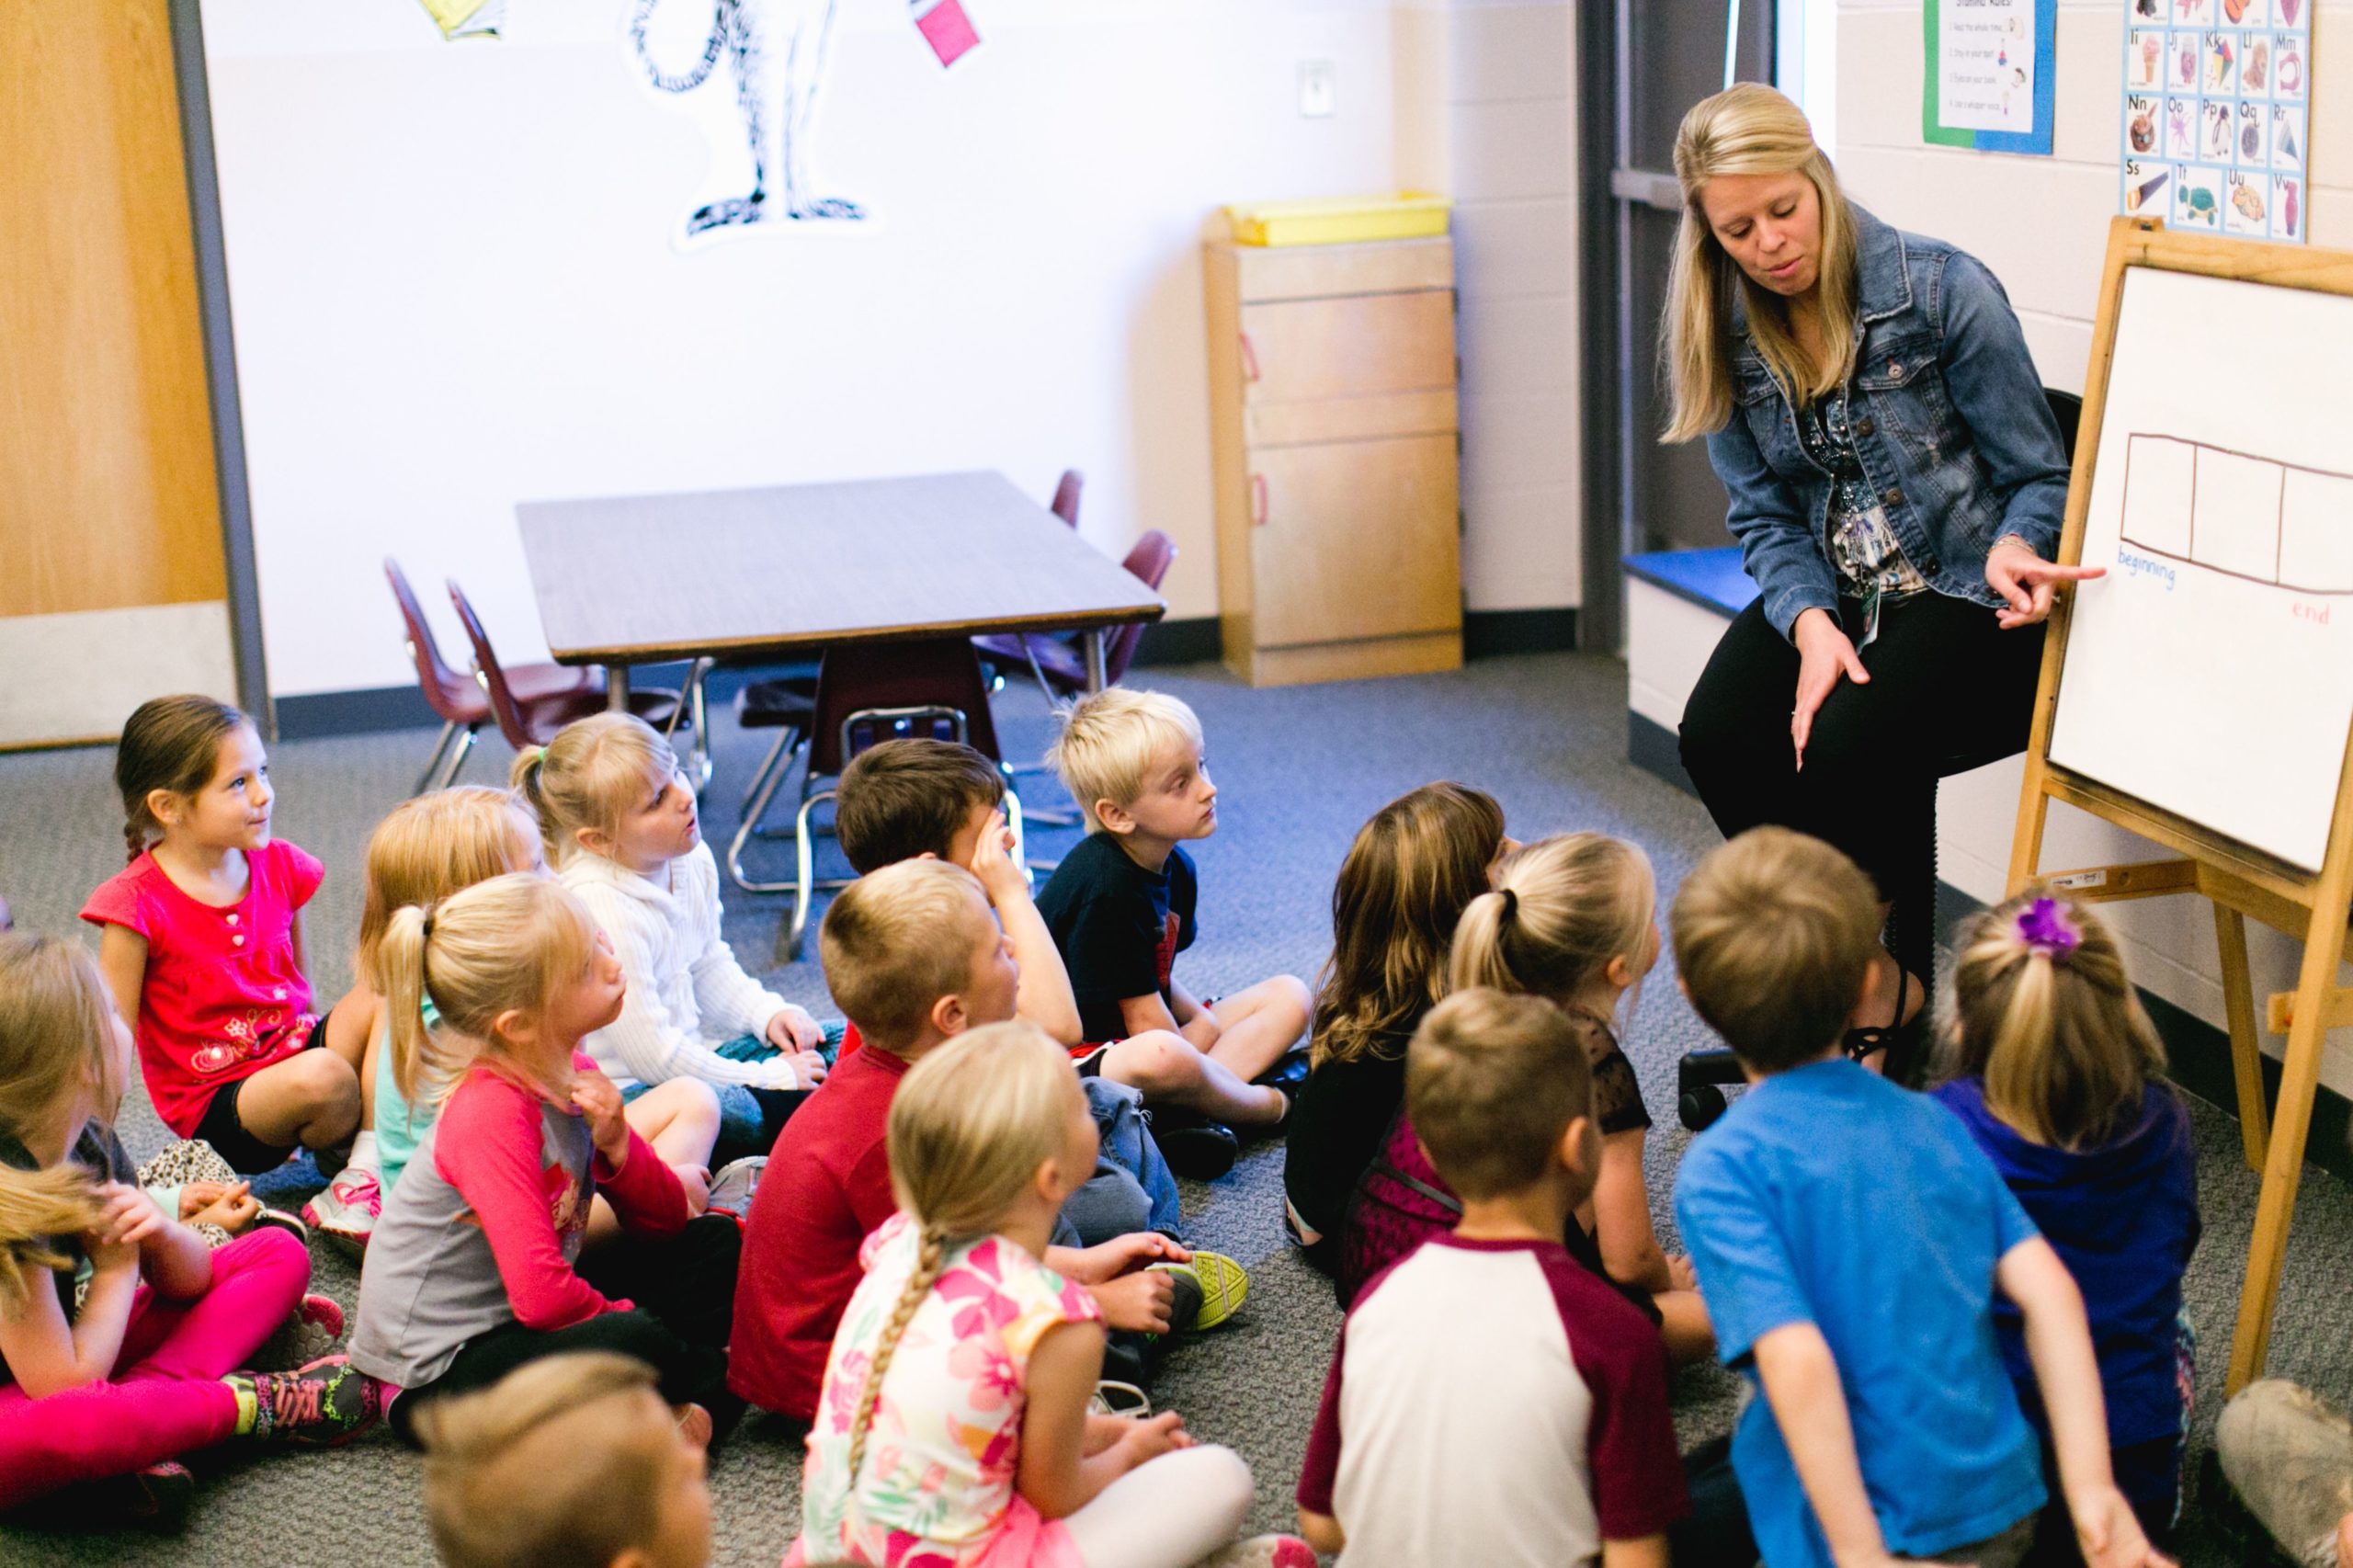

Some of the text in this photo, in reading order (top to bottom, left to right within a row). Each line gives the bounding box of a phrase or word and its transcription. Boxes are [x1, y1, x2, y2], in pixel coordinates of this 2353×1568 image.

[2205, 31, 2222, 48] Kk
[2275, 36, 2296, 51] Mm
[2129, 97, 2146, 110] Nn
[2168, 97, 2183, 112] Oo
[2202, 99, 2217, 119] Pp
[2241, 101, 2259, 128] Qq
[2274, 105, 2286, 120] Rr
[2127, 159, 2140, 175] Ss
[2177, 165, 2187, 179] Tt
[2229, 169, 2245, 186] Uu
[2275, 175, 2289, 190] Vv
[2118, 545, 2176, 591] beginning
[2292, 601, 2330, 625] end
